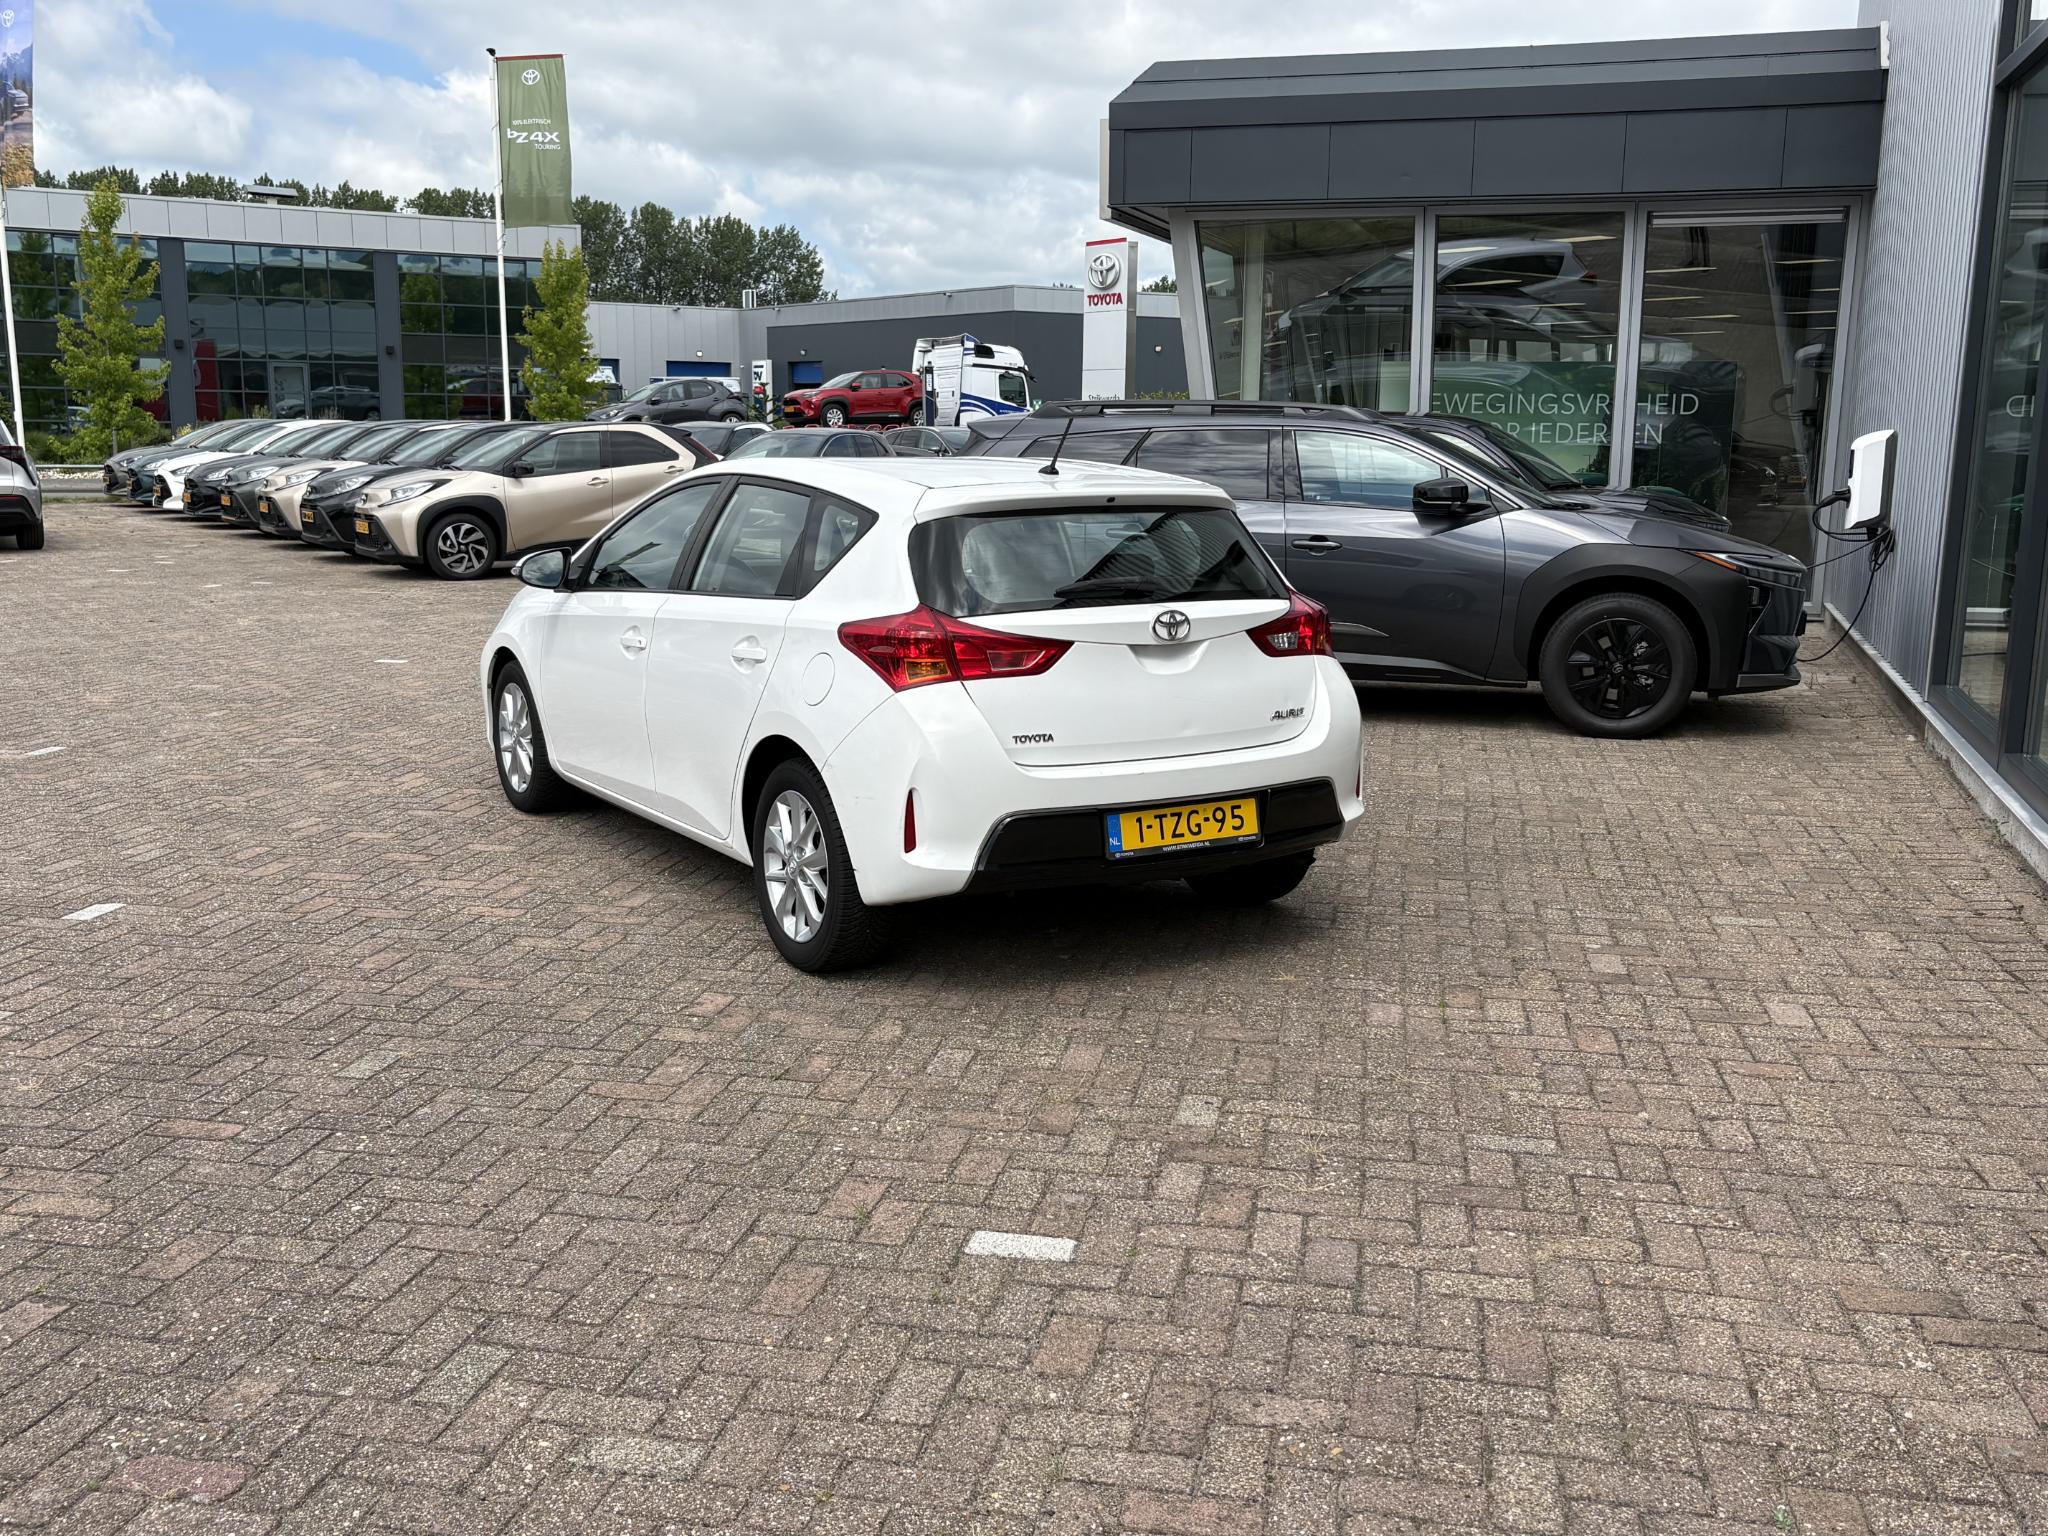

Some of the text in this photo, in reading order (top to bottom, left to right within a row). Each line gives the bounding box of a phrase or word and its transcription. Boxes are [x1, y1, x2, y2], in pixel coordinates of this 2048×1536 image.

[1087, 292, 1123, 307] TOYOTA
[1432, 392, 1699, 415] EWEGINGSVRHEID
[1270, 707, 1304, 720] AURIS
[1012, 733, 1054, 744] TOYOTA
[1135, 804, 1245, 843] 1-TZG-95
[1109, 837, 1121, 846] NL
